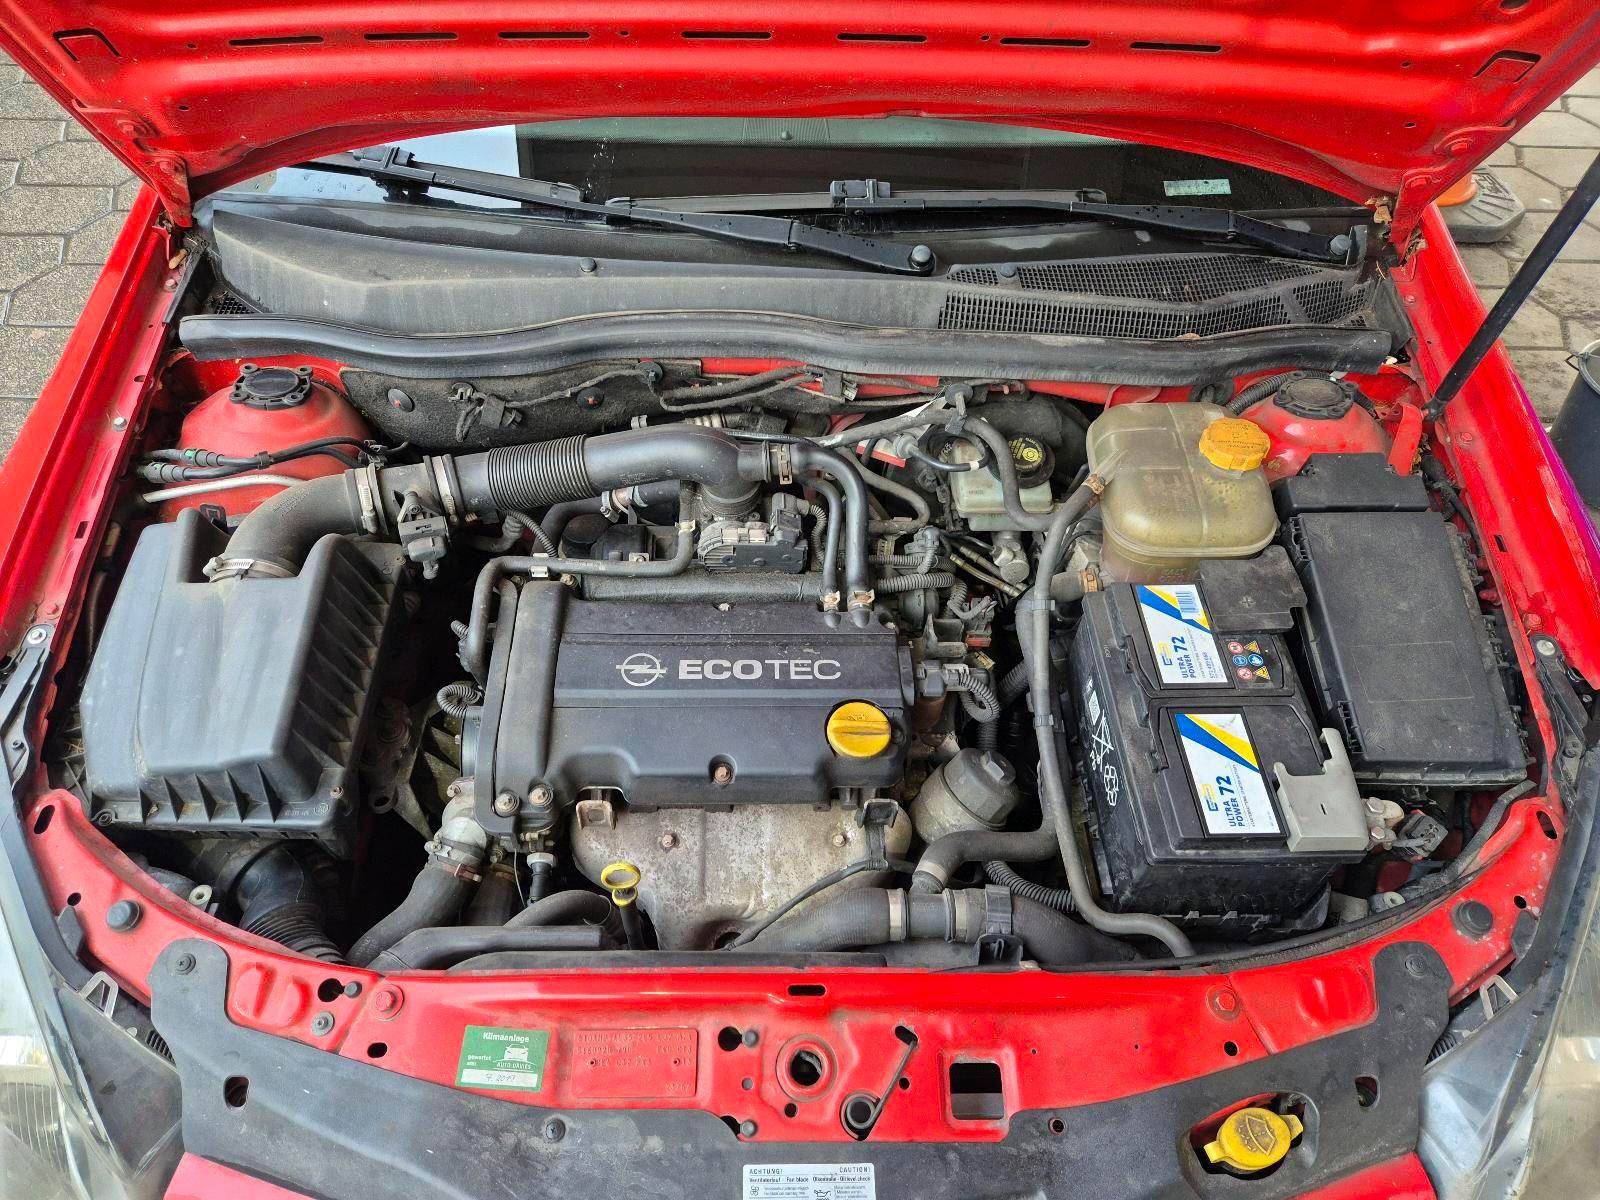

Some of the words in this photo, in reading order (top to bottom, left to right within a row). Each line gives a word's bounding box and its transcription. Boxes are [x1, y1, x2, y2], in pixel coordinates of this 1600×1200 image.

[1170, 636, 1188, 652] 72
[678, 659, 842, 680] ECOTEC
[1176, 656, 1188, 678] ULTRA
[1183, 654, 1196, 678] POWER
[1214, 775, 1235, 795] 72
[1222, 800, 1236, 826] ULTRA
[1230, 798, 1245, 826] POWER
[482, 1032, 530, 1043] Klimaanlage
